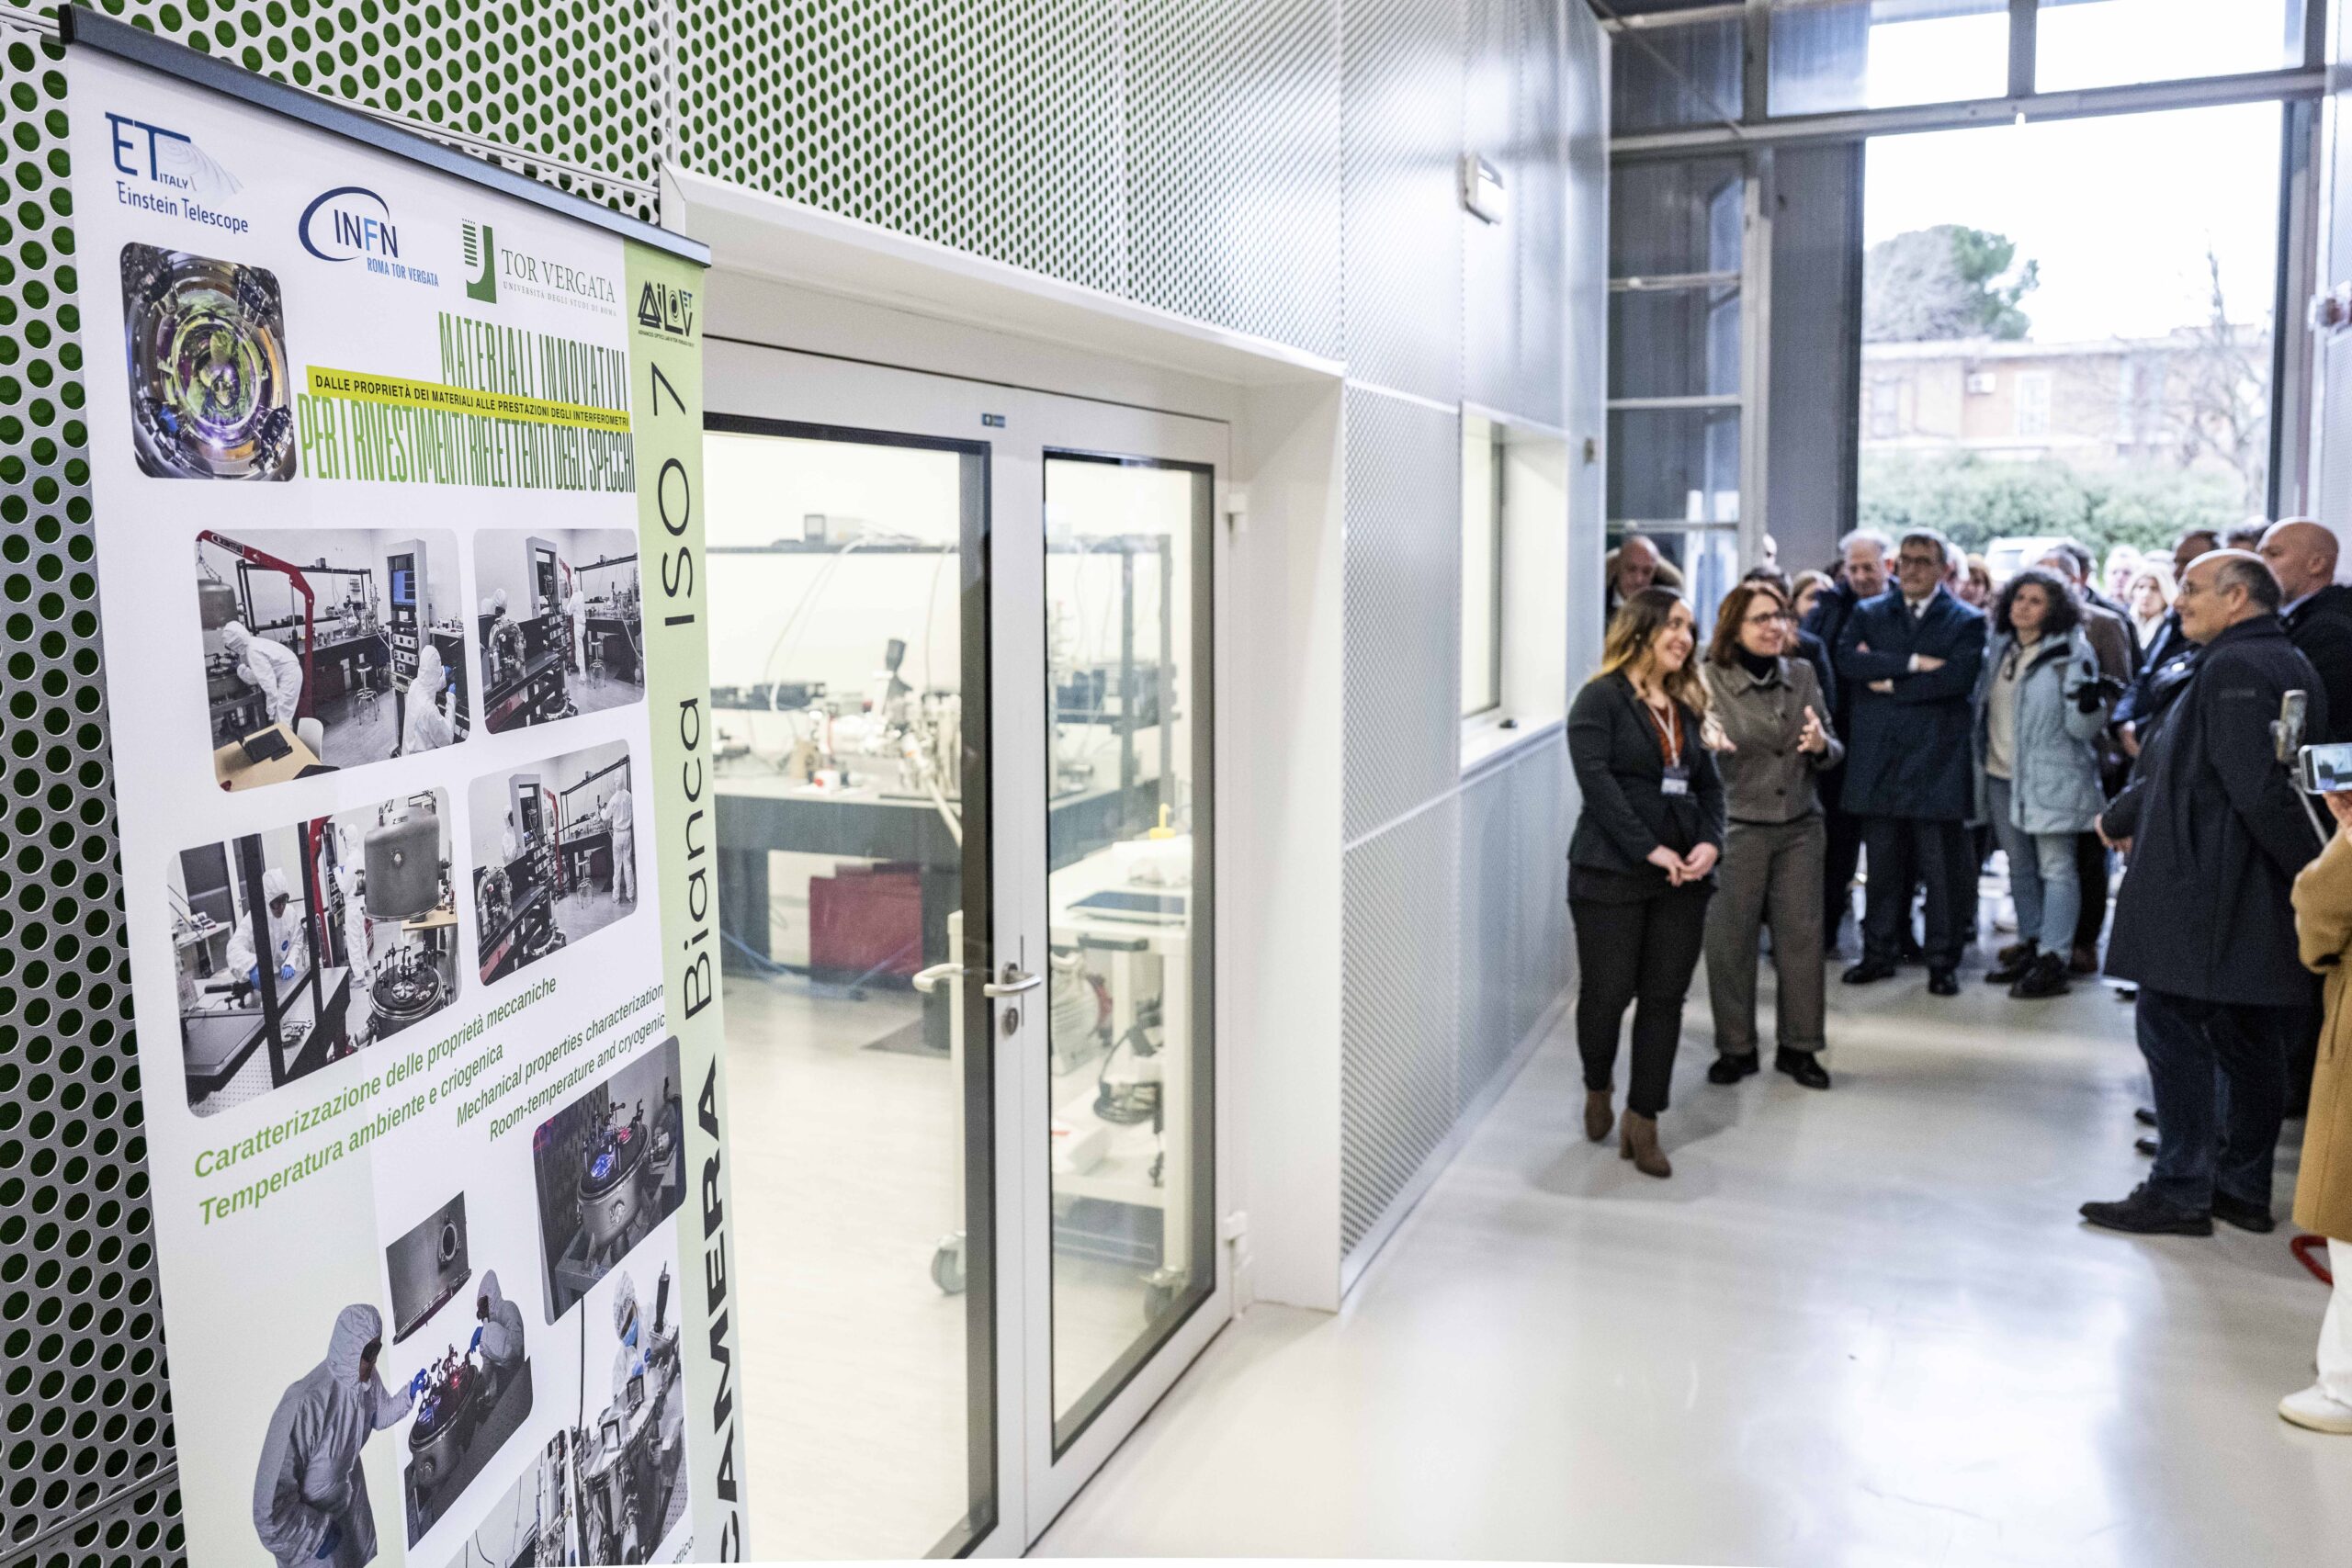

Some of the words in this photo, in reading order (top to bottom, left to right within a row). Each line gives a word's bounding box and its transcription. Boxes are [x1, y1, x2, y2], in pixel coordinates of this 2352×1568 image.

[105, 111, 191, 181] ET
[160, 173, 188, 189] ITALY
[116, 180, 177, 216] Einstein
[181, 197, 249, 234] Telescope
[334, 209, 399, 258] INFN
[367, 256, 390, 276] ROMA
[390, 263, 406, 279] TOR
[407, 266, 439, 288] VERGATA
[501, 249, 538, 283] TOR
[541, 261, 616, 303] VERGATA
[315, 375, 351, 391] DALLE
[354, 380, 412, 399] PROPRIETÀ
[413, 388, 429, 401] DEI
[432, 390, 474, 408] MATERIALI
[476, 398, 496, 411] ALLE
[498, 400, 549, 417] PRESTAZIONI
[551, 407, 571, 420] DEGLI
[572, 411, 629, 427] INTERFEROMETRI
[438, 310, 535, 399] MATERIALI
[538, 333, 628, 412] INNOVATIVI
[650, 361, 686, 416] 7
[297, 393, 340, 479] PER
[350, 400, 469, 486] RIVESTIMENTI
[468, 413, 553, 490] RIFLETTENTI
[552, 423, 587, 491] DEGLI
[587, 428, 636, 493] SPECCHI
[658, 457, 695, 626] ISO
[680, 697, 712, 1021] Bianca
[194, 1077, 380, 1179] Caratterizzazione
[385, 1053, 424, 1088] delle
[427, 1014, 484, 1071] proprietà
[486, 977, 557, 1030] meccaniche
[457, 1064, 522, 1127] Mechanical
[526, 1032, 582, 1085] properties
[586, 984, 664, 1042] characterization
[490, 1058, 595, 1143] Room-temperature
[596, 1043, 616, 1068] and
[618, 1013, 666, 1055] cryogenic
[198, 1140, 344, 1226] Temperatura
[348, 1095, 425, 1152] ambiente
[429, 1088, 437, 1105] e
[441, 1043, 503, 1098] criogenica
